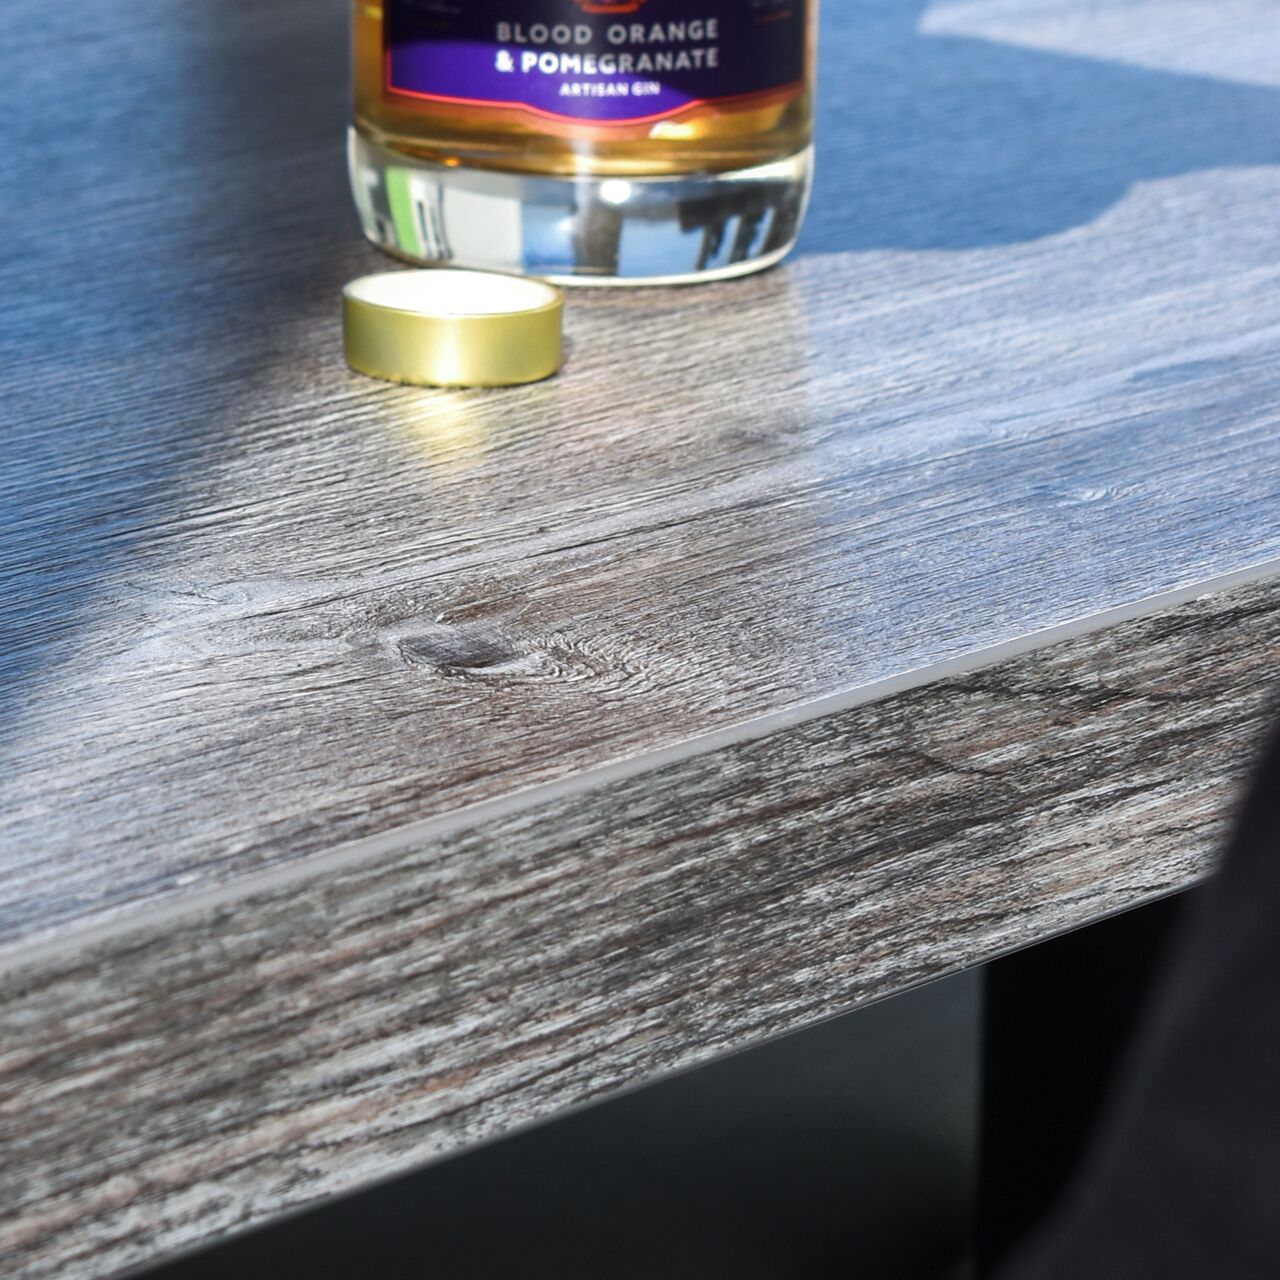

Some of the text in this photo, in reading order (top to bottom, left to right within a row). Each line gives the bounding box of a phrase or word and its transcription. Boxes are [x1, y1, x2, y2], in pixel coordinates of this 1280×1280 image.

[496, 19, 719, 45] BLOOD ORANGE
[495, 47, 719, 75] & POMEGRANATE
[558, 81, 661, 98] ARTISAN GIN
